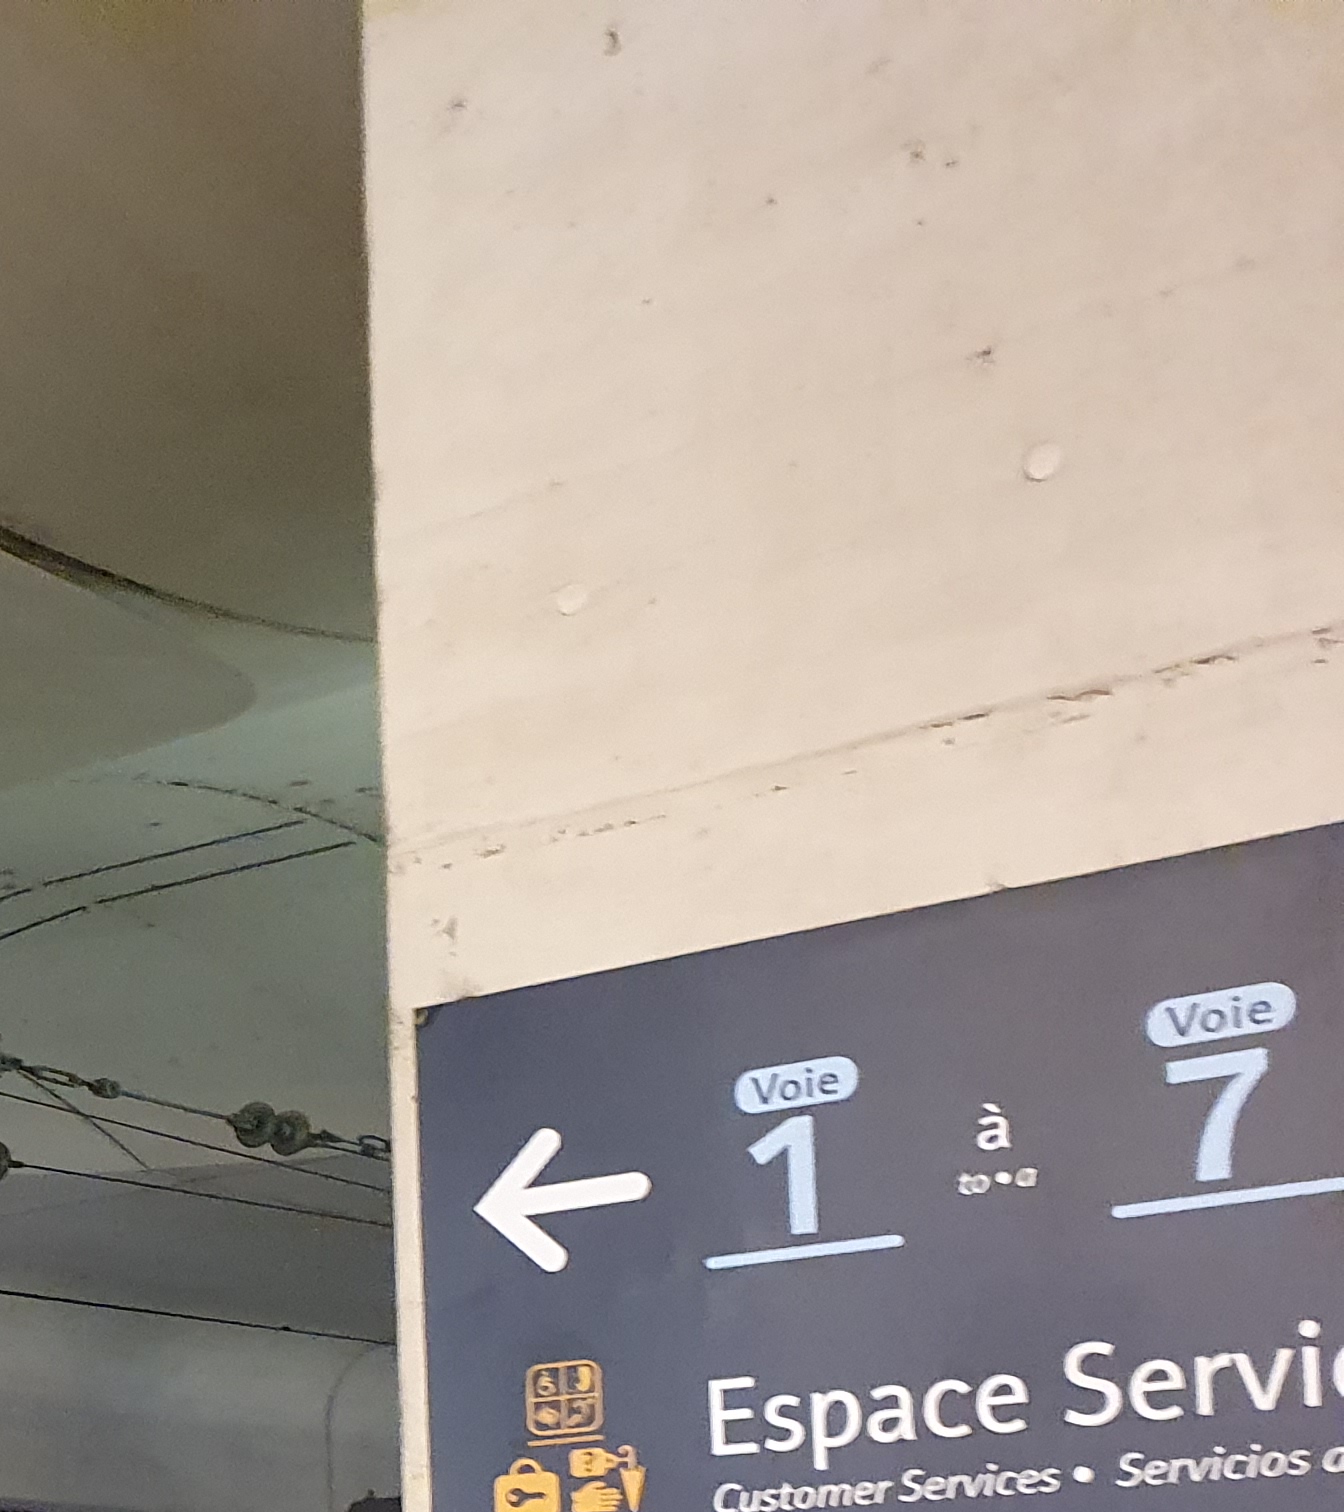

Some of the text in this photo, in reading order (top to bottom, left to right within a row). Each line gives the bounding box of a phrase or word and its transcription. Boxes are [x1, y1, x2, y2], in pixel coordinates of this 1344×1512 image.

[1165, 996, 1273, 1037] Voie
[749, 1067, 839, 1104] Voie
[1165, 1047, 1269, 1182] 7
[976, 1102, 1011, 1151] à
[747, 1114, 819, 1235] 1
[708, 1319, 1344, 1471] Espace Servi
[897, 1462, 1062, 1503] Services
[1114, 1443, 1312, 1488] Servicios
